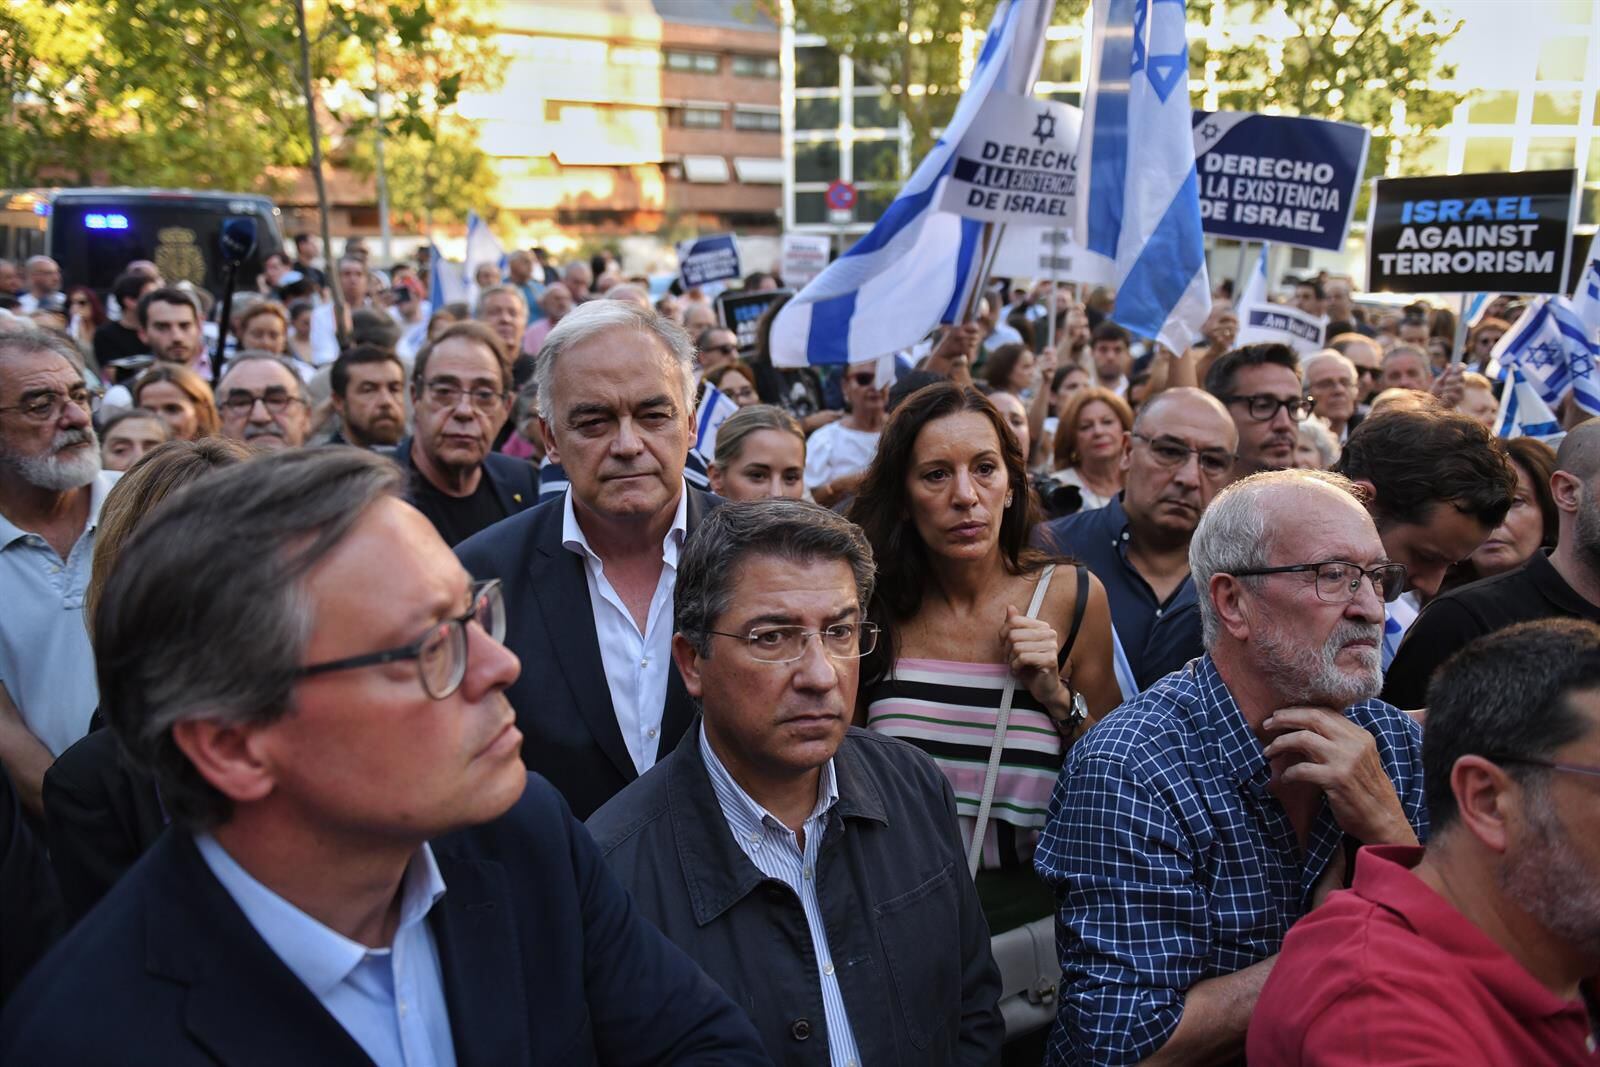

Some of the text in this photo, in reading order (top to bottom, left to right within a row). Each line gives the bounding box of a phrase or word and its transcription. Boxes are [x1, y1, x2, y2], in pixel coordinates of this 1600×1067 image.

[973, 164, 986, 186] A
[989, 165, 1008, 189] LA
[1204, 152, 1335, 184] DERECHO
[967, 188, 1067, 217] DE ISRAEL
[1205, 175, 1229, 199] LA
[1232, 178, 1340, 212] EXISTENCIA
[1233, 203, 1325, 233] ISRAEL
[1401, 196, 1540, 225] ISRAEL
[1397, 224, 1539, 250] AGAINST
[1378, 250, 1555, 275] TERRORISM
